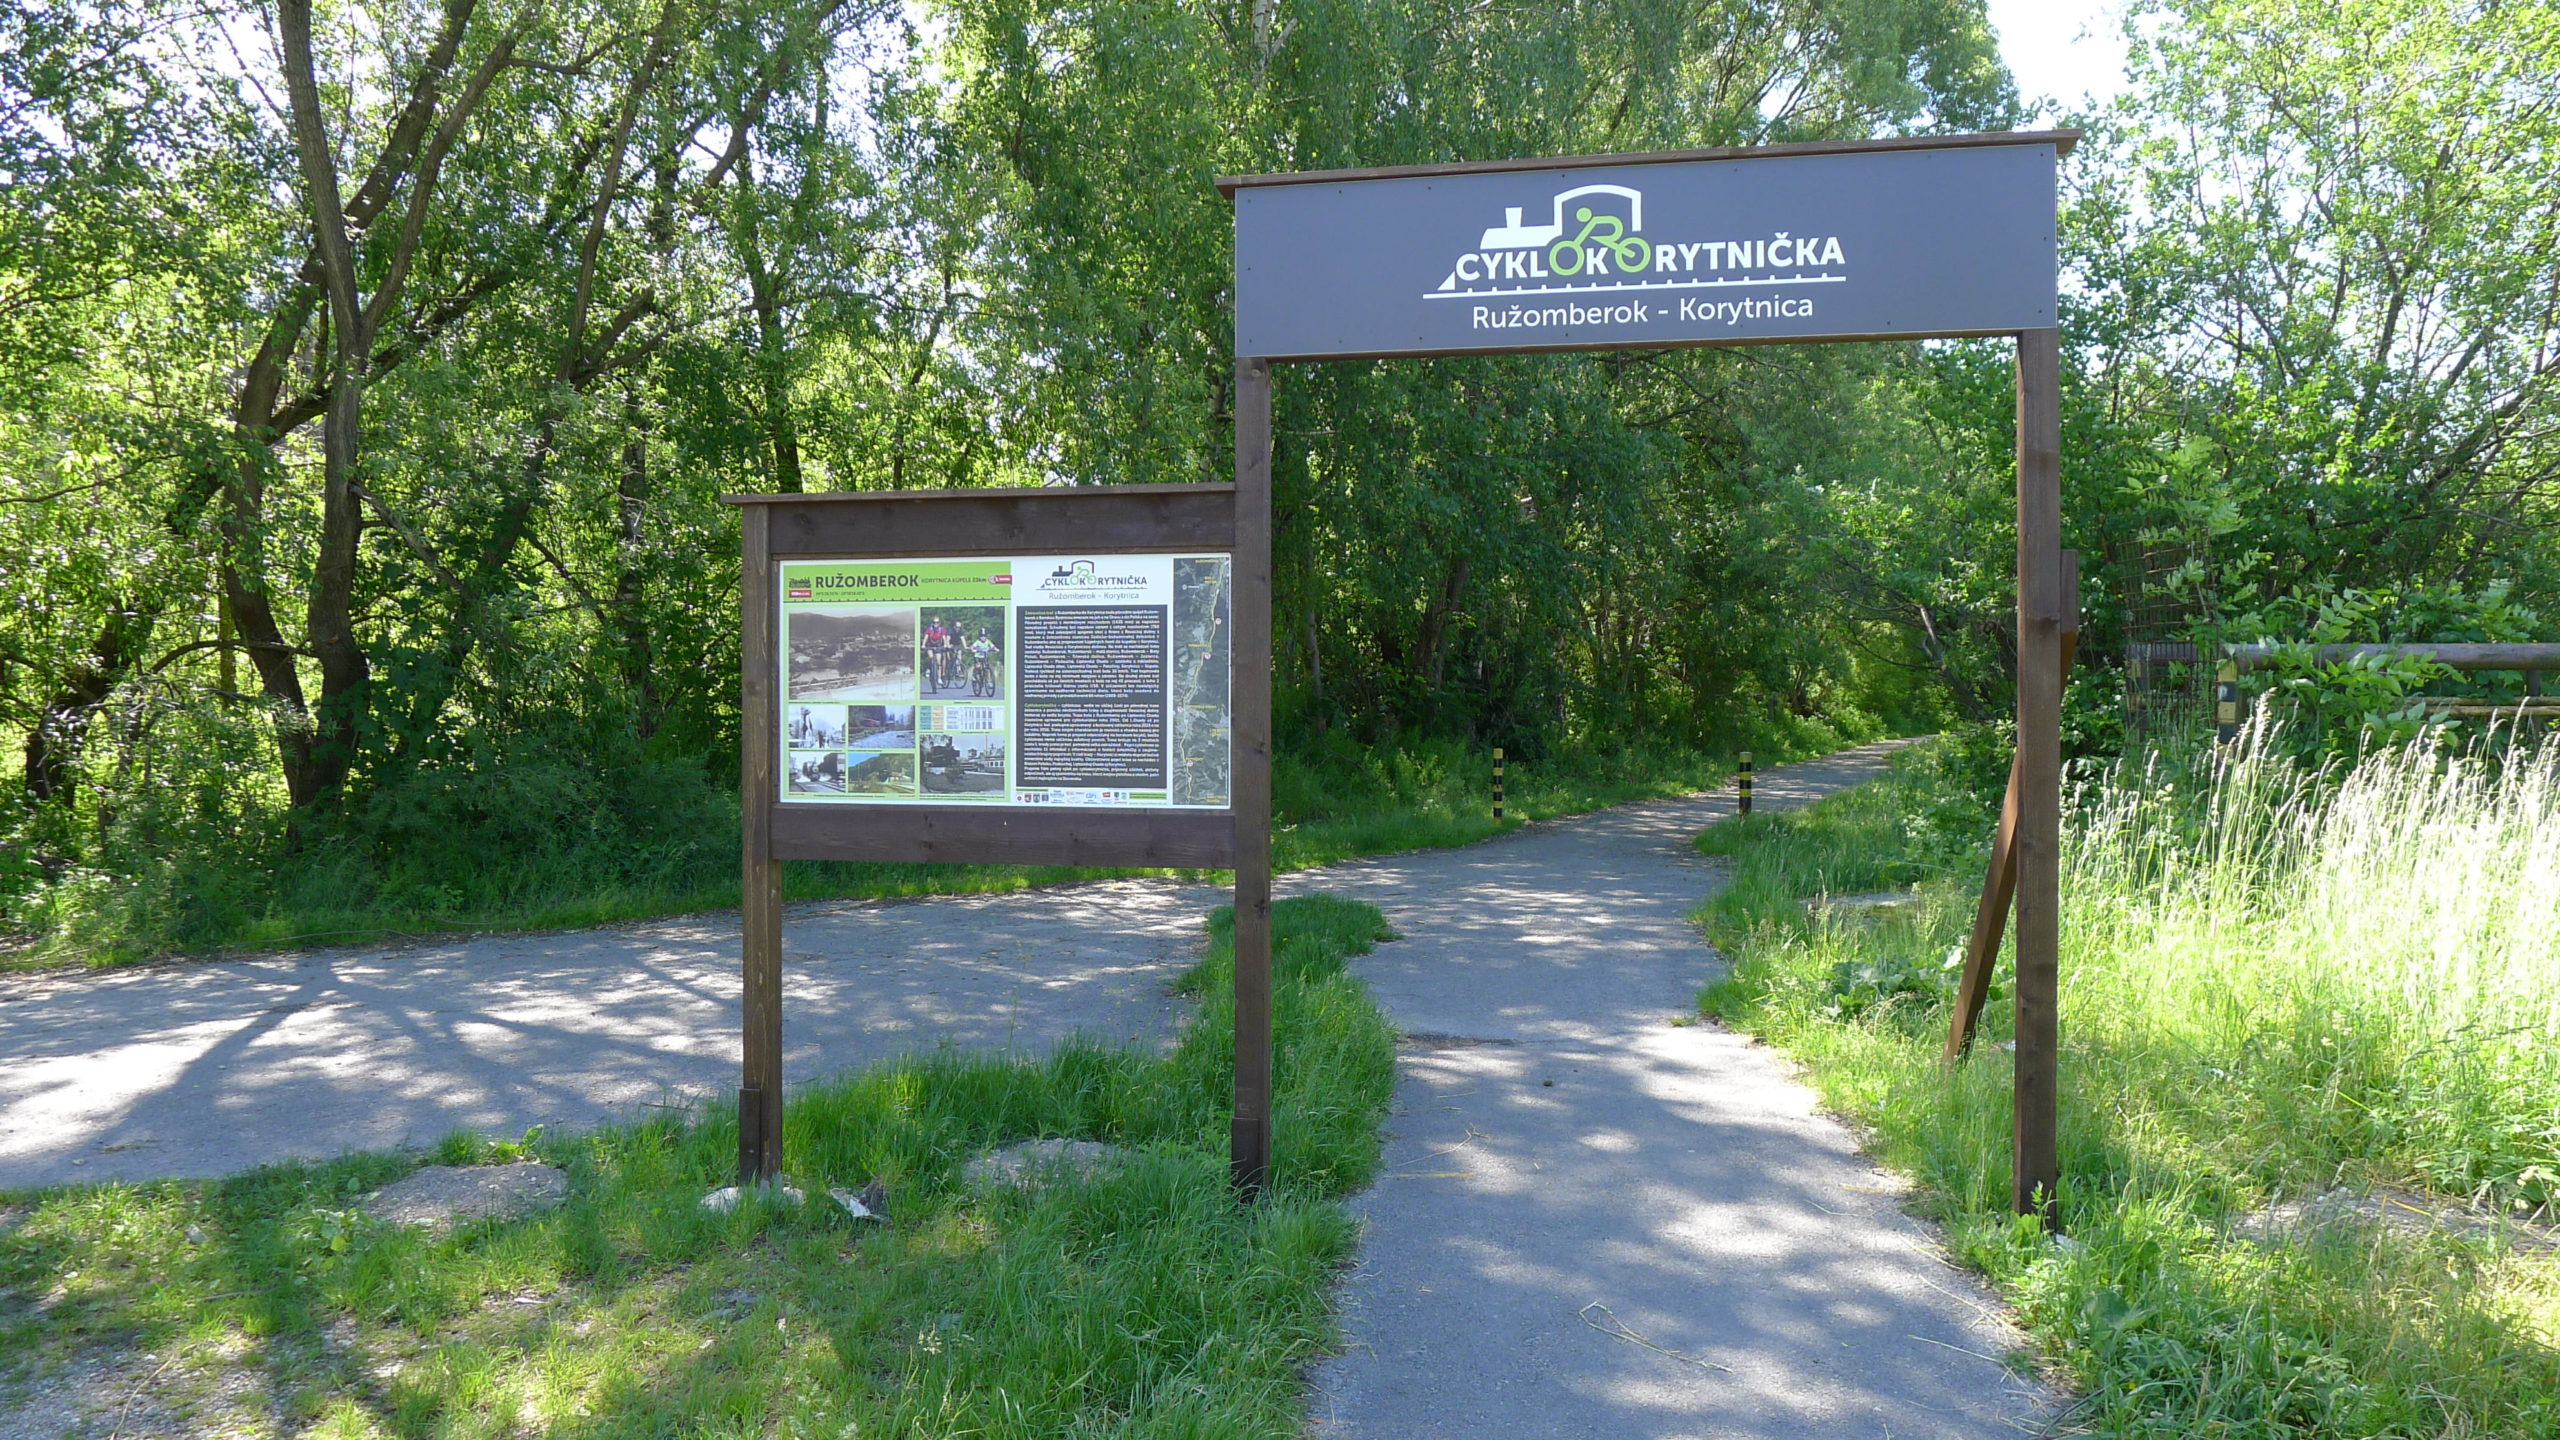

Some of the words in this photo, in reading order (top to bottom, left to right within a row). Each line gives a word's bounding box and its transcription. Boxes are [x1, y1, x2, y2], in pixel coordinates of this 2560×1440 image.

[1472, 300, 1648, 329] Ružomberok
[1679, 295, 1814, 326] Korytnica
[815, 573, 919, 589] RUŽOMBEROK
[1049, 591, 1096, 600] Ružomberok
[1104, 590, 1139, 600] Korytnica
